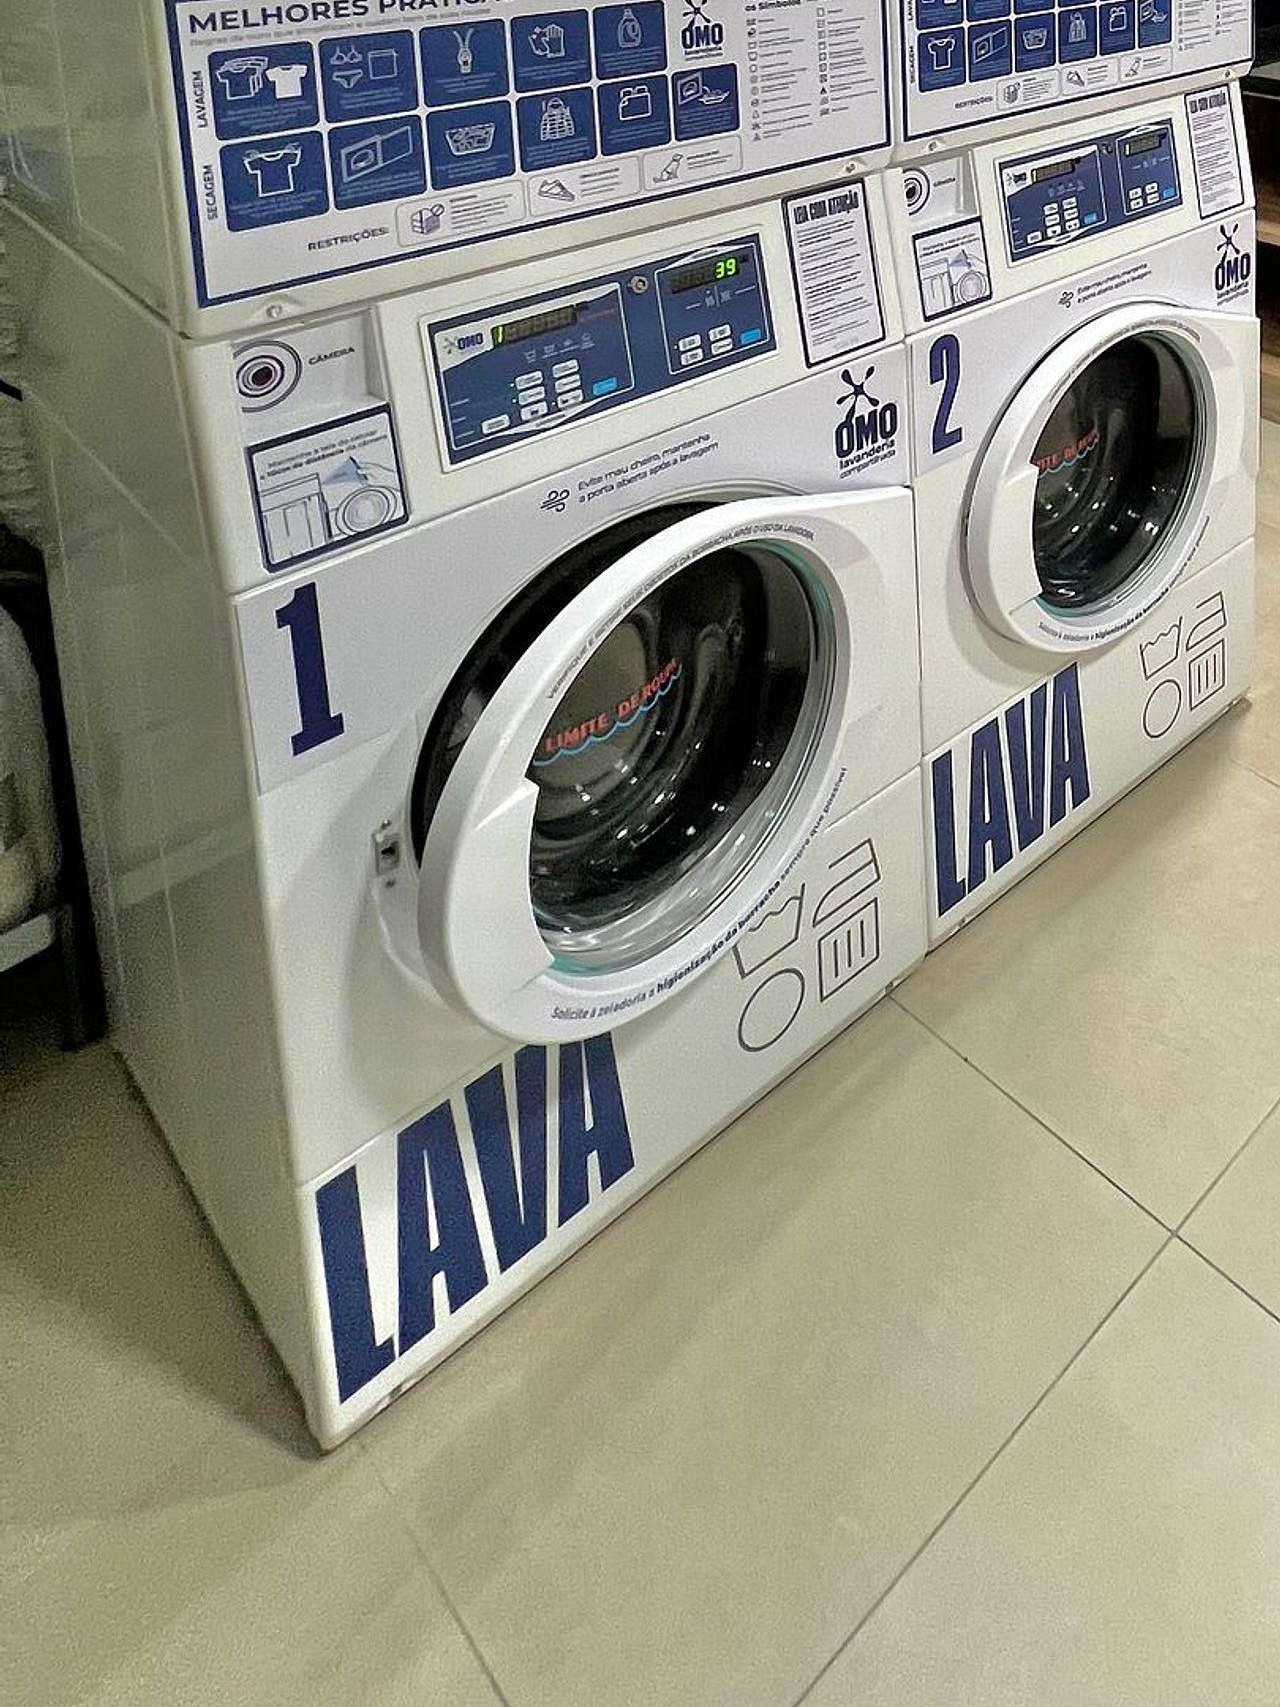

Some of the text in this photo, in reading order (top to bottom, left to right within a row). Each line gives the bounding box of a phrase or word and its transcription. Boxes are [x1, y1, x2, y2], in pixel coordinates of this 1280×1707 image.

[681, 23, 724, 49] OMO
[192, 70, 208, 128] LAVAGEM
[202, 165, 218, 220] SECAGEM
[715, 258, 736, 279] 39
[1215, 253, 1251, 291] OMO
[308, 346, 355, 365] CÂMERA
[457, 332, 484, 349] OMO
[929, 334, 963, 454] 2
[834, 402, 898, 458] OMO
[839, 439, 896, 470] lavanderia
[578, 433, 711, 491] Evite mau cheiro, mantenha
[579, 441, 719, 503] a porta aberta após a lavagem
[276, 582, 344, 756] 1
[544, 712, 612, 753] LIMITE
[616, 693, 641, 719] DE
[932, 661, 1090, 917] LAVA
[551, 1005, 589, 1020] Solicite
[597, 992, 646, 1017] zeladoria
[657, 940, 724, 993] higienização
[724, 928, 738, 942] da
[737, 880, 780, 929] borracha
[780, 838, 811, 881] sempre
[810, 814, 824, 838] que
[823, 766, 848, 813] possível
[316, 1031, 635, 1405] LAVA
